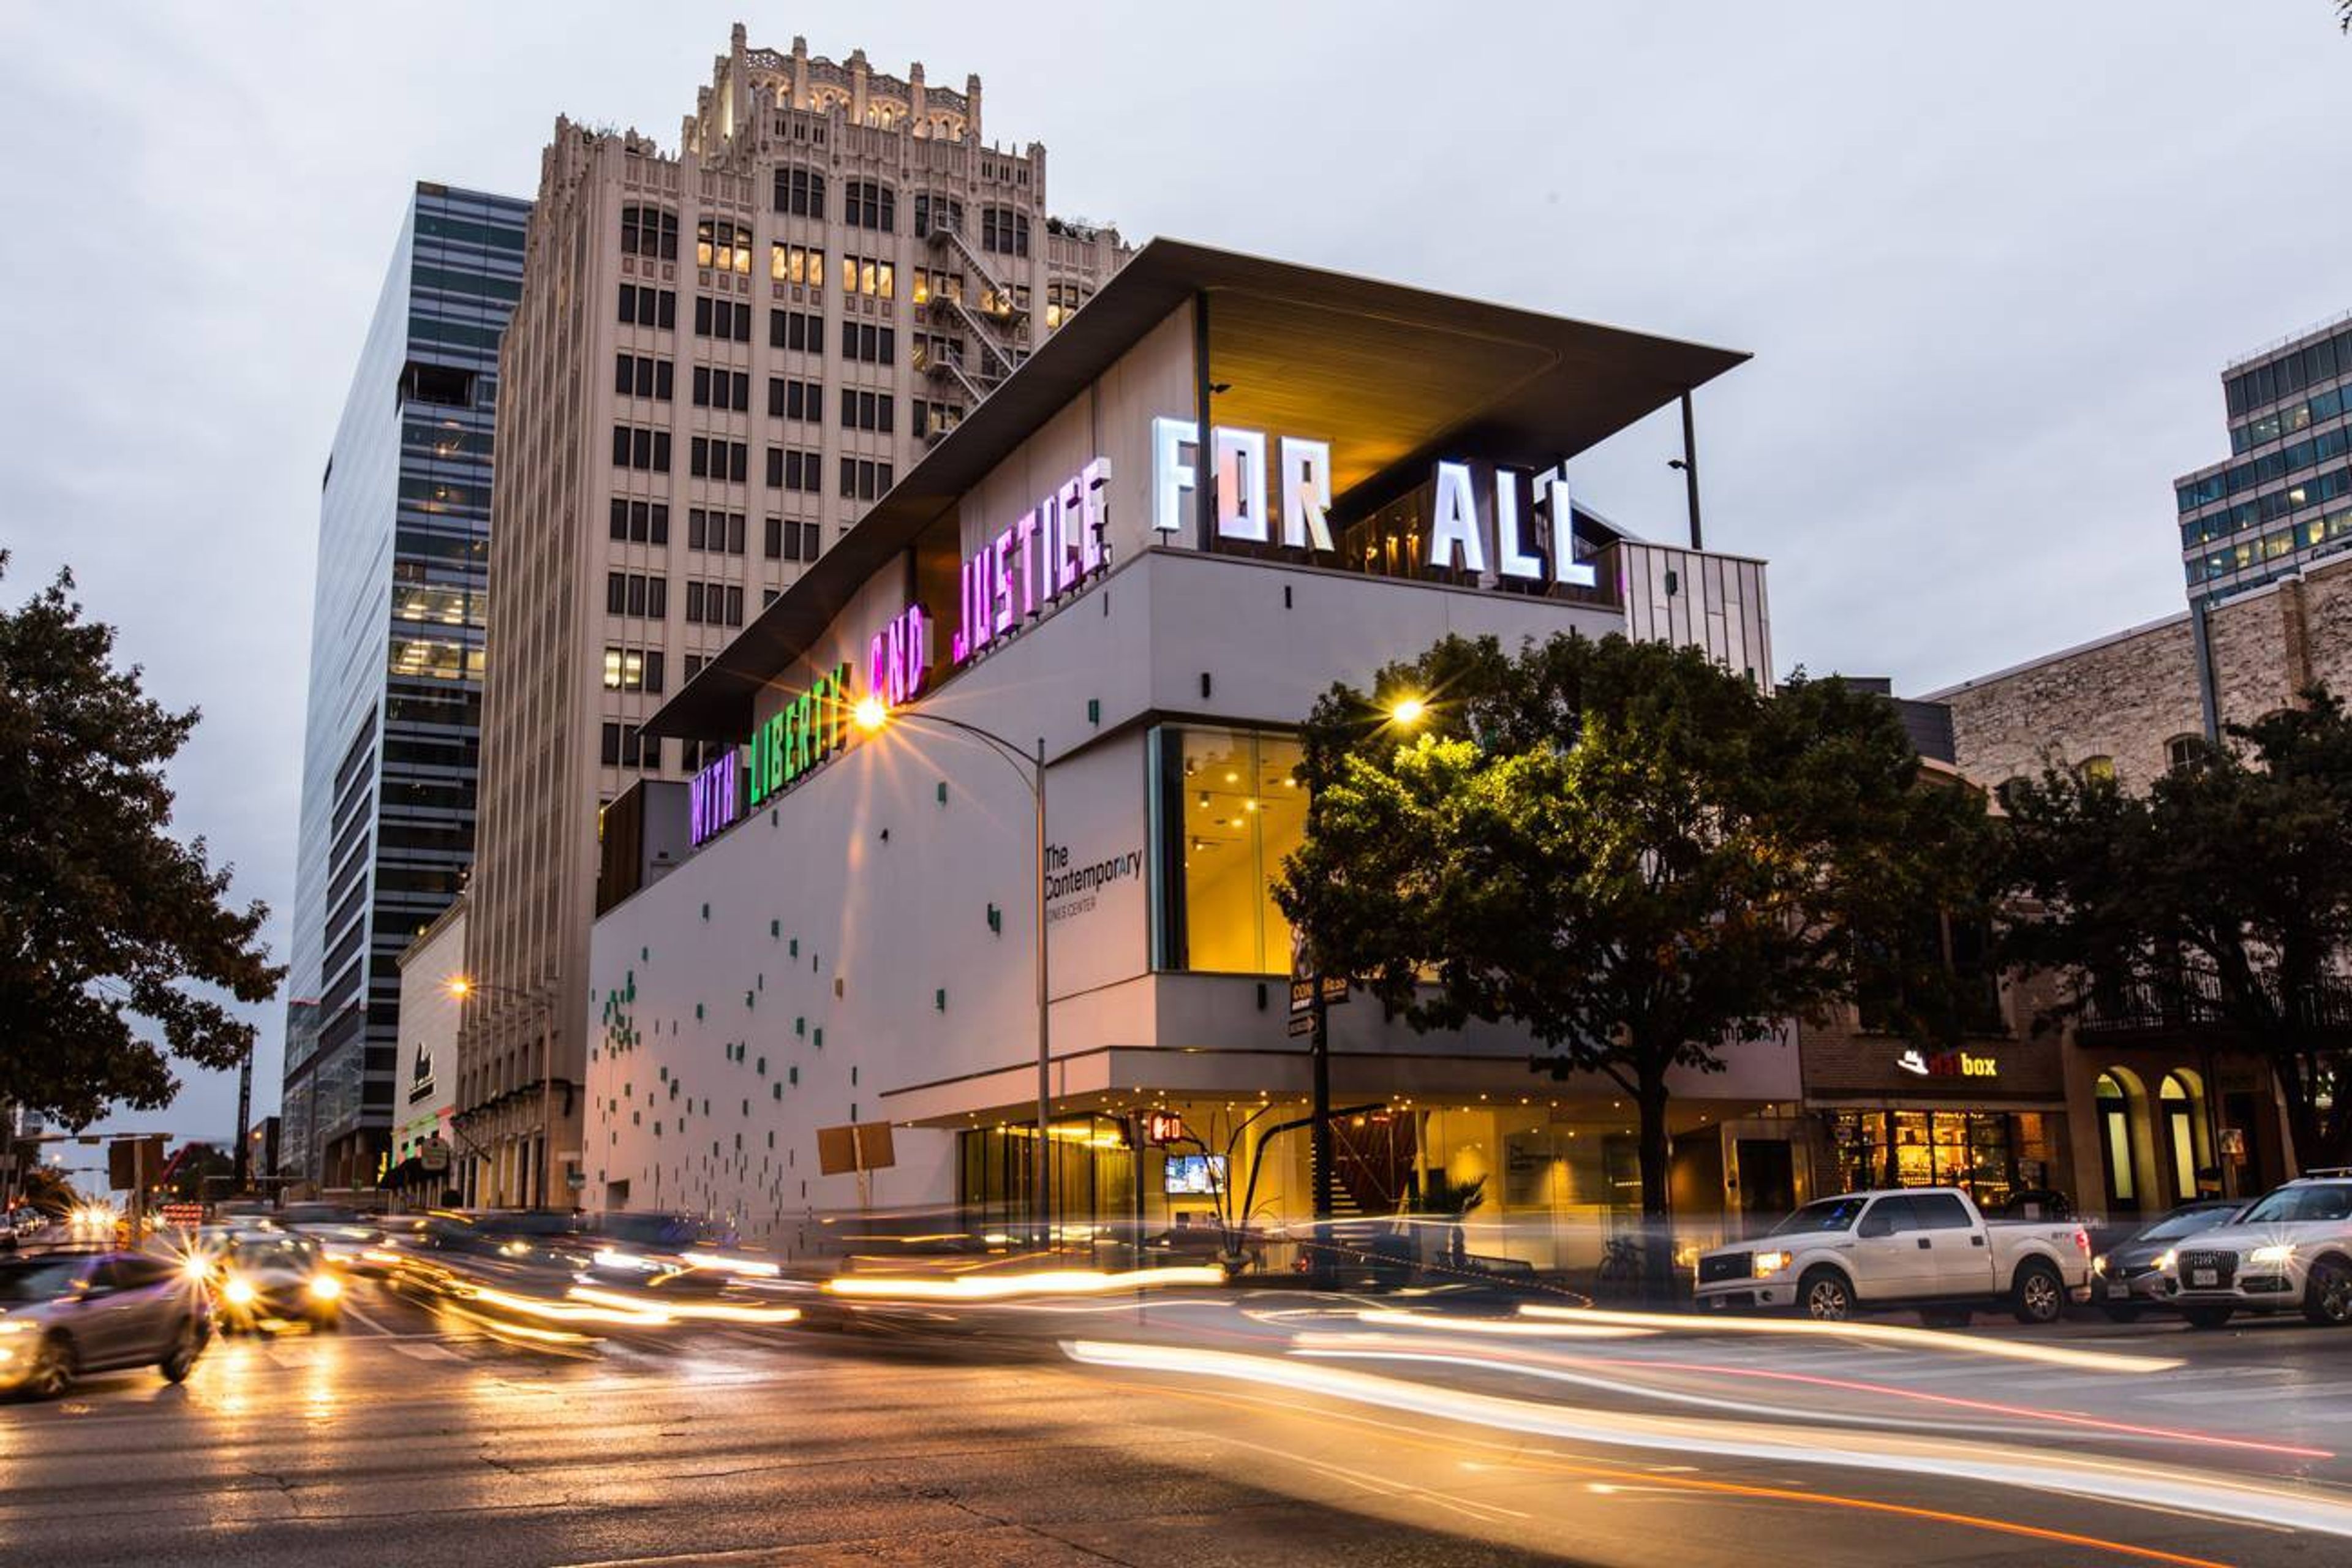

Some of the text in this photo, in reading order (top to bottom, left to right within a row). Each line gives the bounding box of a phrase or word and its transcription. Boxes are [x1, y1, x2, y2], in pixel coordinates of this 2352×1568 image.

[1152, 417, 1596, 586] FOR ALL
[691, 457, 1112, 845] WITH LIBERTY AND JUSTICE
[1045, 844, 1068, 872] The
